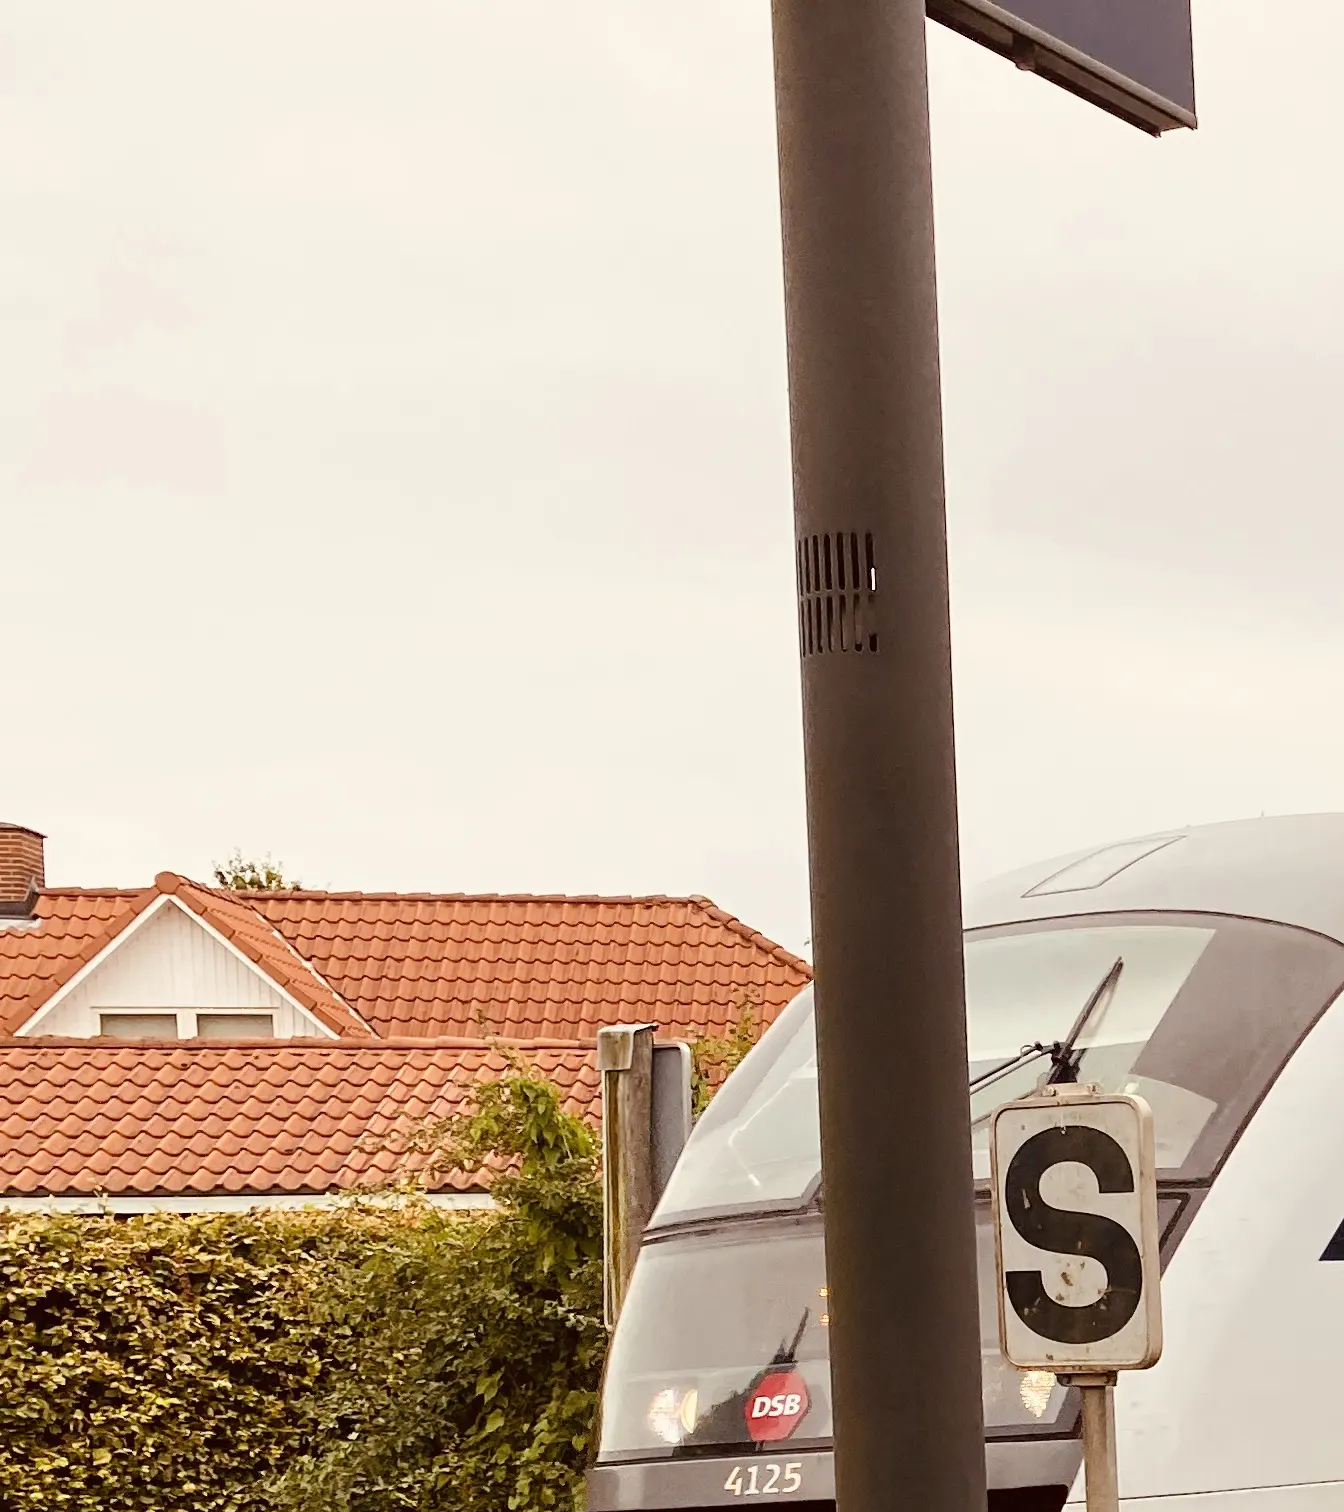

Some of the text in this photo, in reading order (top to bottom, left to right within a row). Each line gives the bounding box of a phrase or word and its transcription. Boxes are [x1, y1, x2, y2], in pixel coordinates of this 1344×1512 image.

[1005, 1125, 1142, 1344] S
[751, 1394, 801, 1419] DSB
[723, 1462, 803, 1496] 4125
